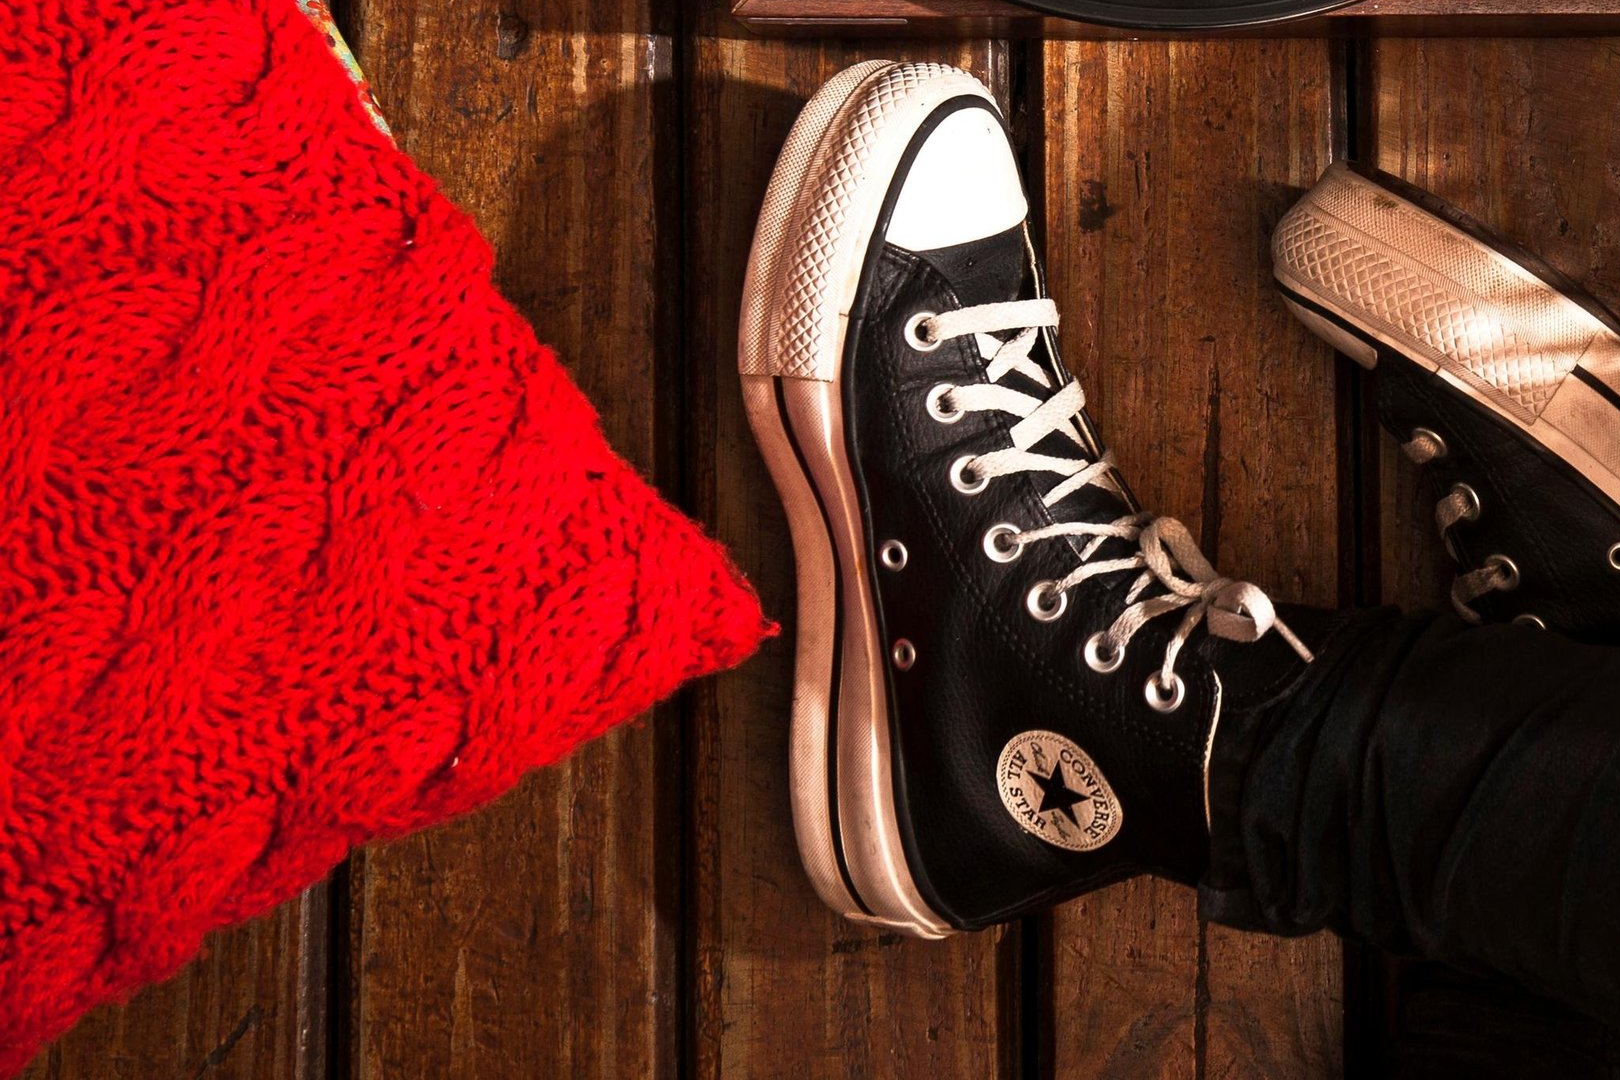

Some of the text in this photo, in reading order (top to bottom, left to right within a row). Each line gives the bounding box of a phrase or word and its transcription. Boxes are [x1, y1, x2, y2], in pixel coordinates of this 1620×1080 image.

[1007, 750, 1028, 780] ALL
[1010, 786, 1047, 830] STAR
[1060, 749, 1110, 839] CONVERSE
